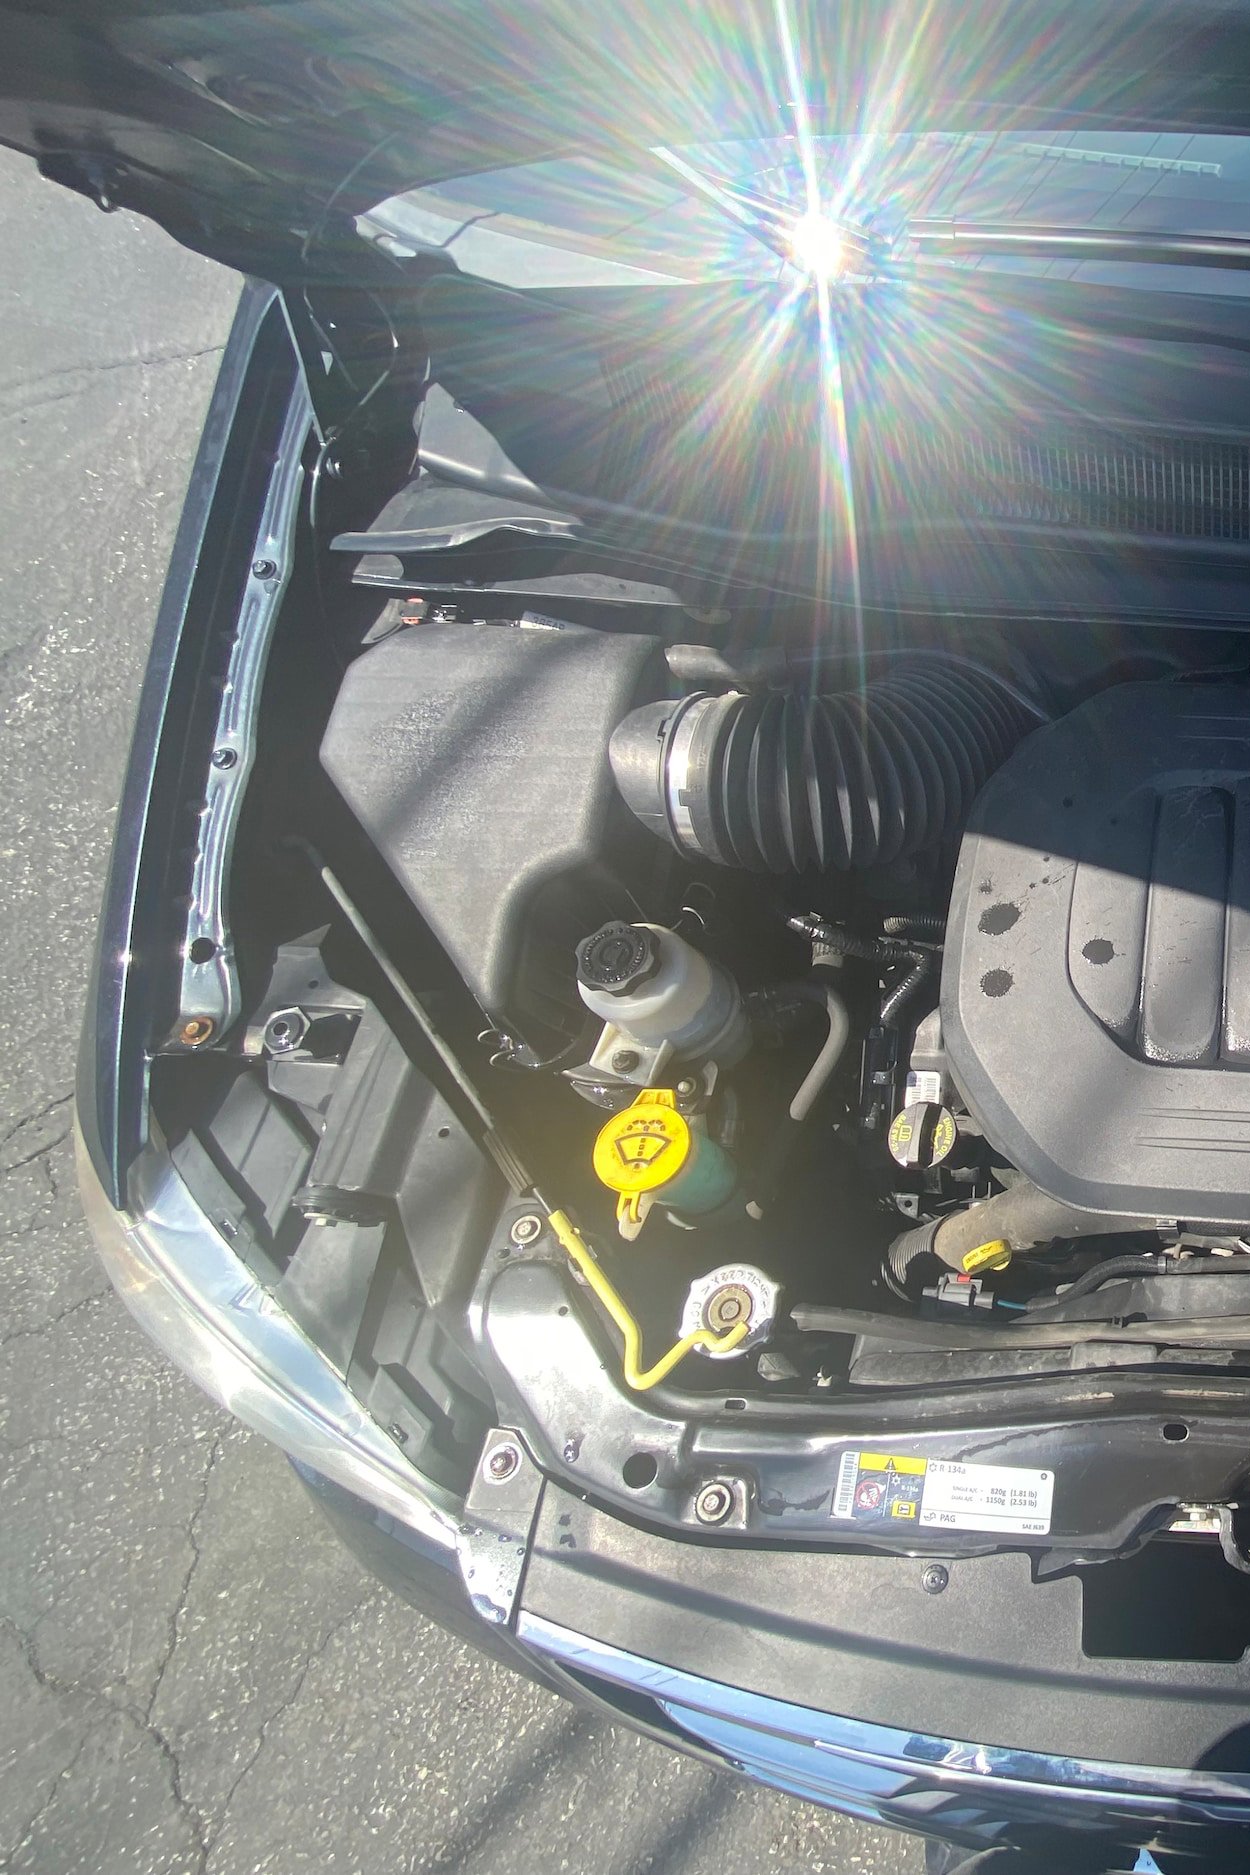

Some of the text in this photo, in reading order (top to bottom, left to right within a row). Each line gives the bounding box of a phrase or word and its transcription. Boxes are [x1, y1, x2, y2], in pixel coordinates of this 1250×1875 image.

[894, 1112, 908, 1129] SAE
[935, 1116, 954, 1158] ENGINE OIL
[939, 1464, 967, 1475] R 134a
[990, 1487, 1007, 1497] 820g
[1010, 1489, 1027, 1498] (1.81
[1028, 1490, 1038, 1499] lb)
[986, 1496, 1006, 1506] 1150g
[1010, 1498, 1027, 1507] (2.53
[1028, 1500, 1037, 1508] lb)
[939, 1513, 956, 1523] PAG
[1021, 1523, 1032, 1531] SAE
